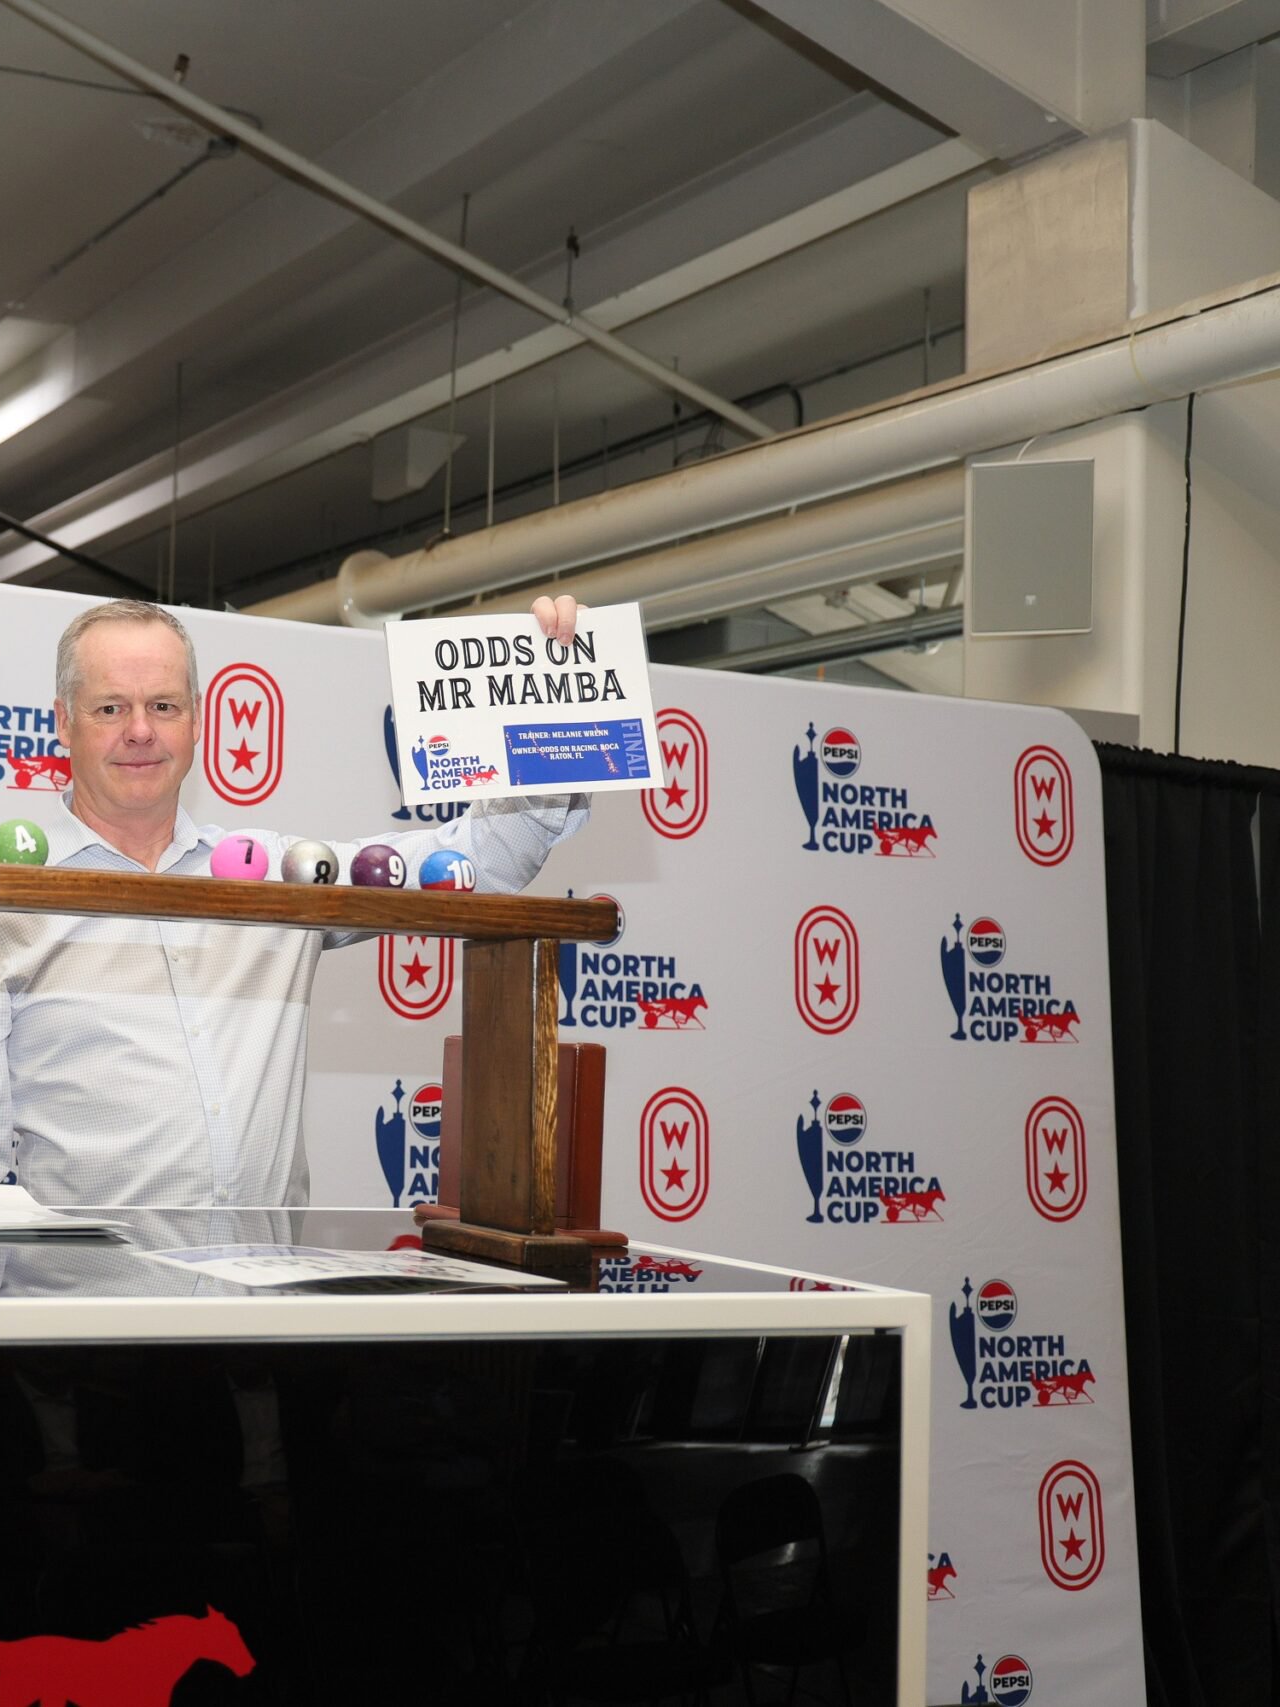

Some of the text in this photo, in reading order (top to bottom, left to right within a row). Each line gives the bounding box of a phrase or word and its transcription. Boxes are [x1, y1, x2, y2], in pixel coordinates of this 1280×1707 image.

[434, 631, 596, 671] ODDS ON
[417, 669, 626, 713] MR MAMBA
[227, 697, 263, 730] W
[518, 729, 609, 740] TRAINER: MELANIE WRENN
[512, 747, 539, 755] OWNER:
[541, 746, 559, 754] ODDS
[560, 745, 570, 753] ON
[600, 743, 619, 751] BOCA
[575, 752, 584, 760] FL
[621, 721, 647, 777] FINAL
[660, 740, 690, 769] W
[823, 746, 858, 759] PEPSI
[429, 755, 480, 769] NORTH
[431, 765, 496, 779] AMERICA
[432, 779, 462, 790] CUP
[823, 783, 908, 807] NORTH
[1031, 775, 1056, 801] W
[823, 808, 932, 830] AMERICA
[15, 825, 37, 854] 4
[823, 831, 873, 853] CUP
[237, 839, 254, 865] 7
[313, 860, 331, 884] 8
[388, 855, 405, 886] 9
[447, 860, 476, 890] 10
[813, 937, 842, 965] W
[969, 936, 1003, 949] PEPSI
[581, 954, 676, 978] NORTH
[580, 979, 702, 1003] AMERICA
[970, 974, 1050, 994] NORTH
[580, 1004, 637, 1029] CUP
[970, 997, 1073, 1016] AMERICA
[972, 1022, 1017, 1041] CUP
[412, 1105, 441, 1117] PEP
[828, 1113, 864, 1126] PEPSI
[659, 1119, 690, 1149] W
[1042, 1128, 1068, 1153] W
[828, 1151, 914, 1173] NORTH
[829, 1177, 939, 1198] AMERICA
[828, 1203, 879, 1223] CUP
[979, 1299, 1015, 1312] PEPSI
[980, 1336, 1064, 1357] NORTH
[980, 1359, 1091, 1383] AMERICA
[980, 1386, 1031, 1408] CUP
[1056, 1491, 1084, 1521] W
[993, 1675, 1030, 1689] PEPSI
